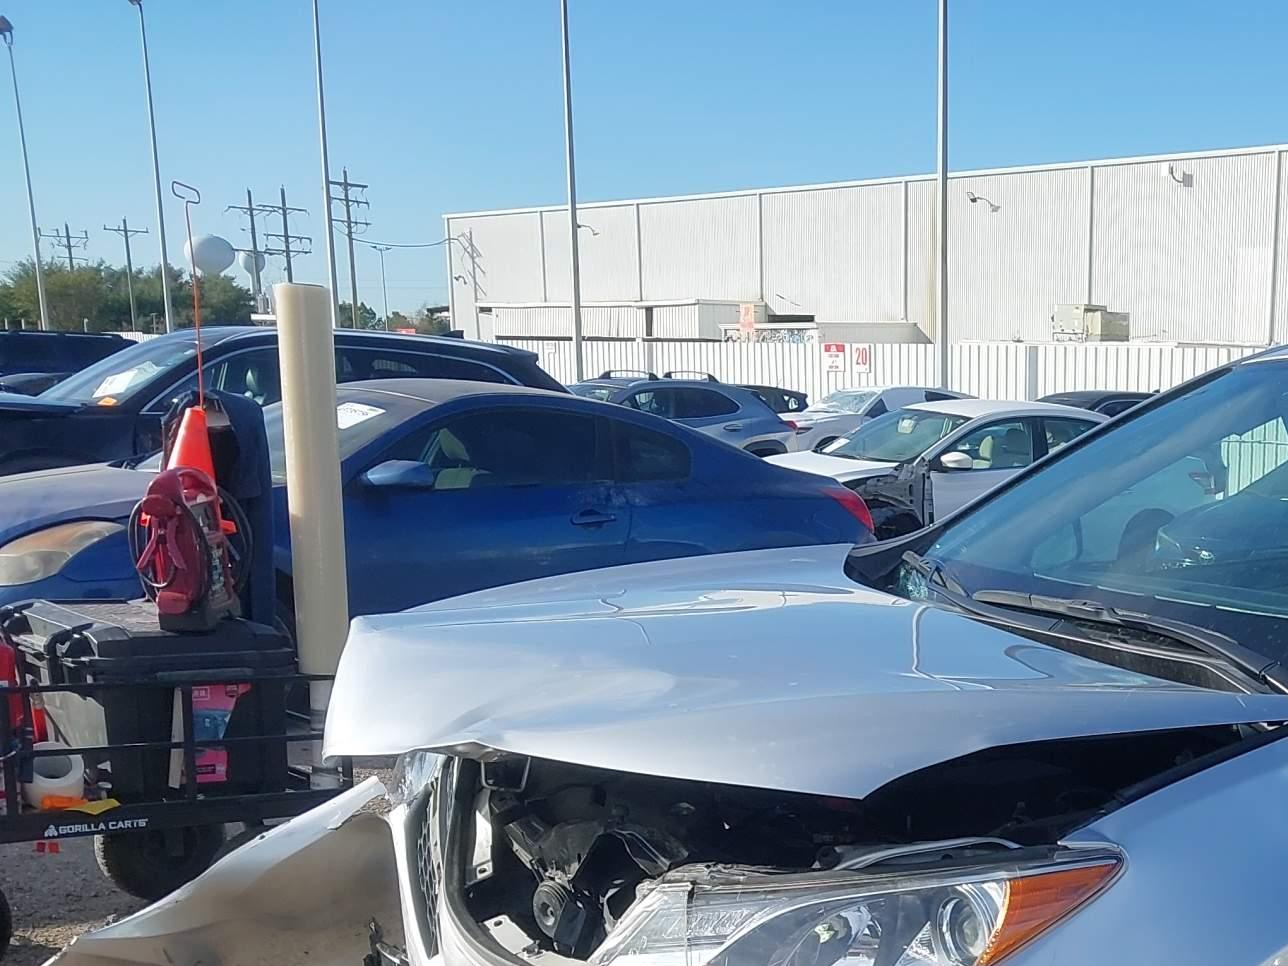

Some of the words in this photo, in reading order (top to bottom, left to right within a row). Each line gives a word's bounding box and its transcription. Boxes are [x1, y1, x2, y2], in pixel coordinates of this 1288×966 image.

[855, 347, 868, 365] 20
[58, 822, 106, 835] GORILLA
[108, 818, 149, 830] CARTS
